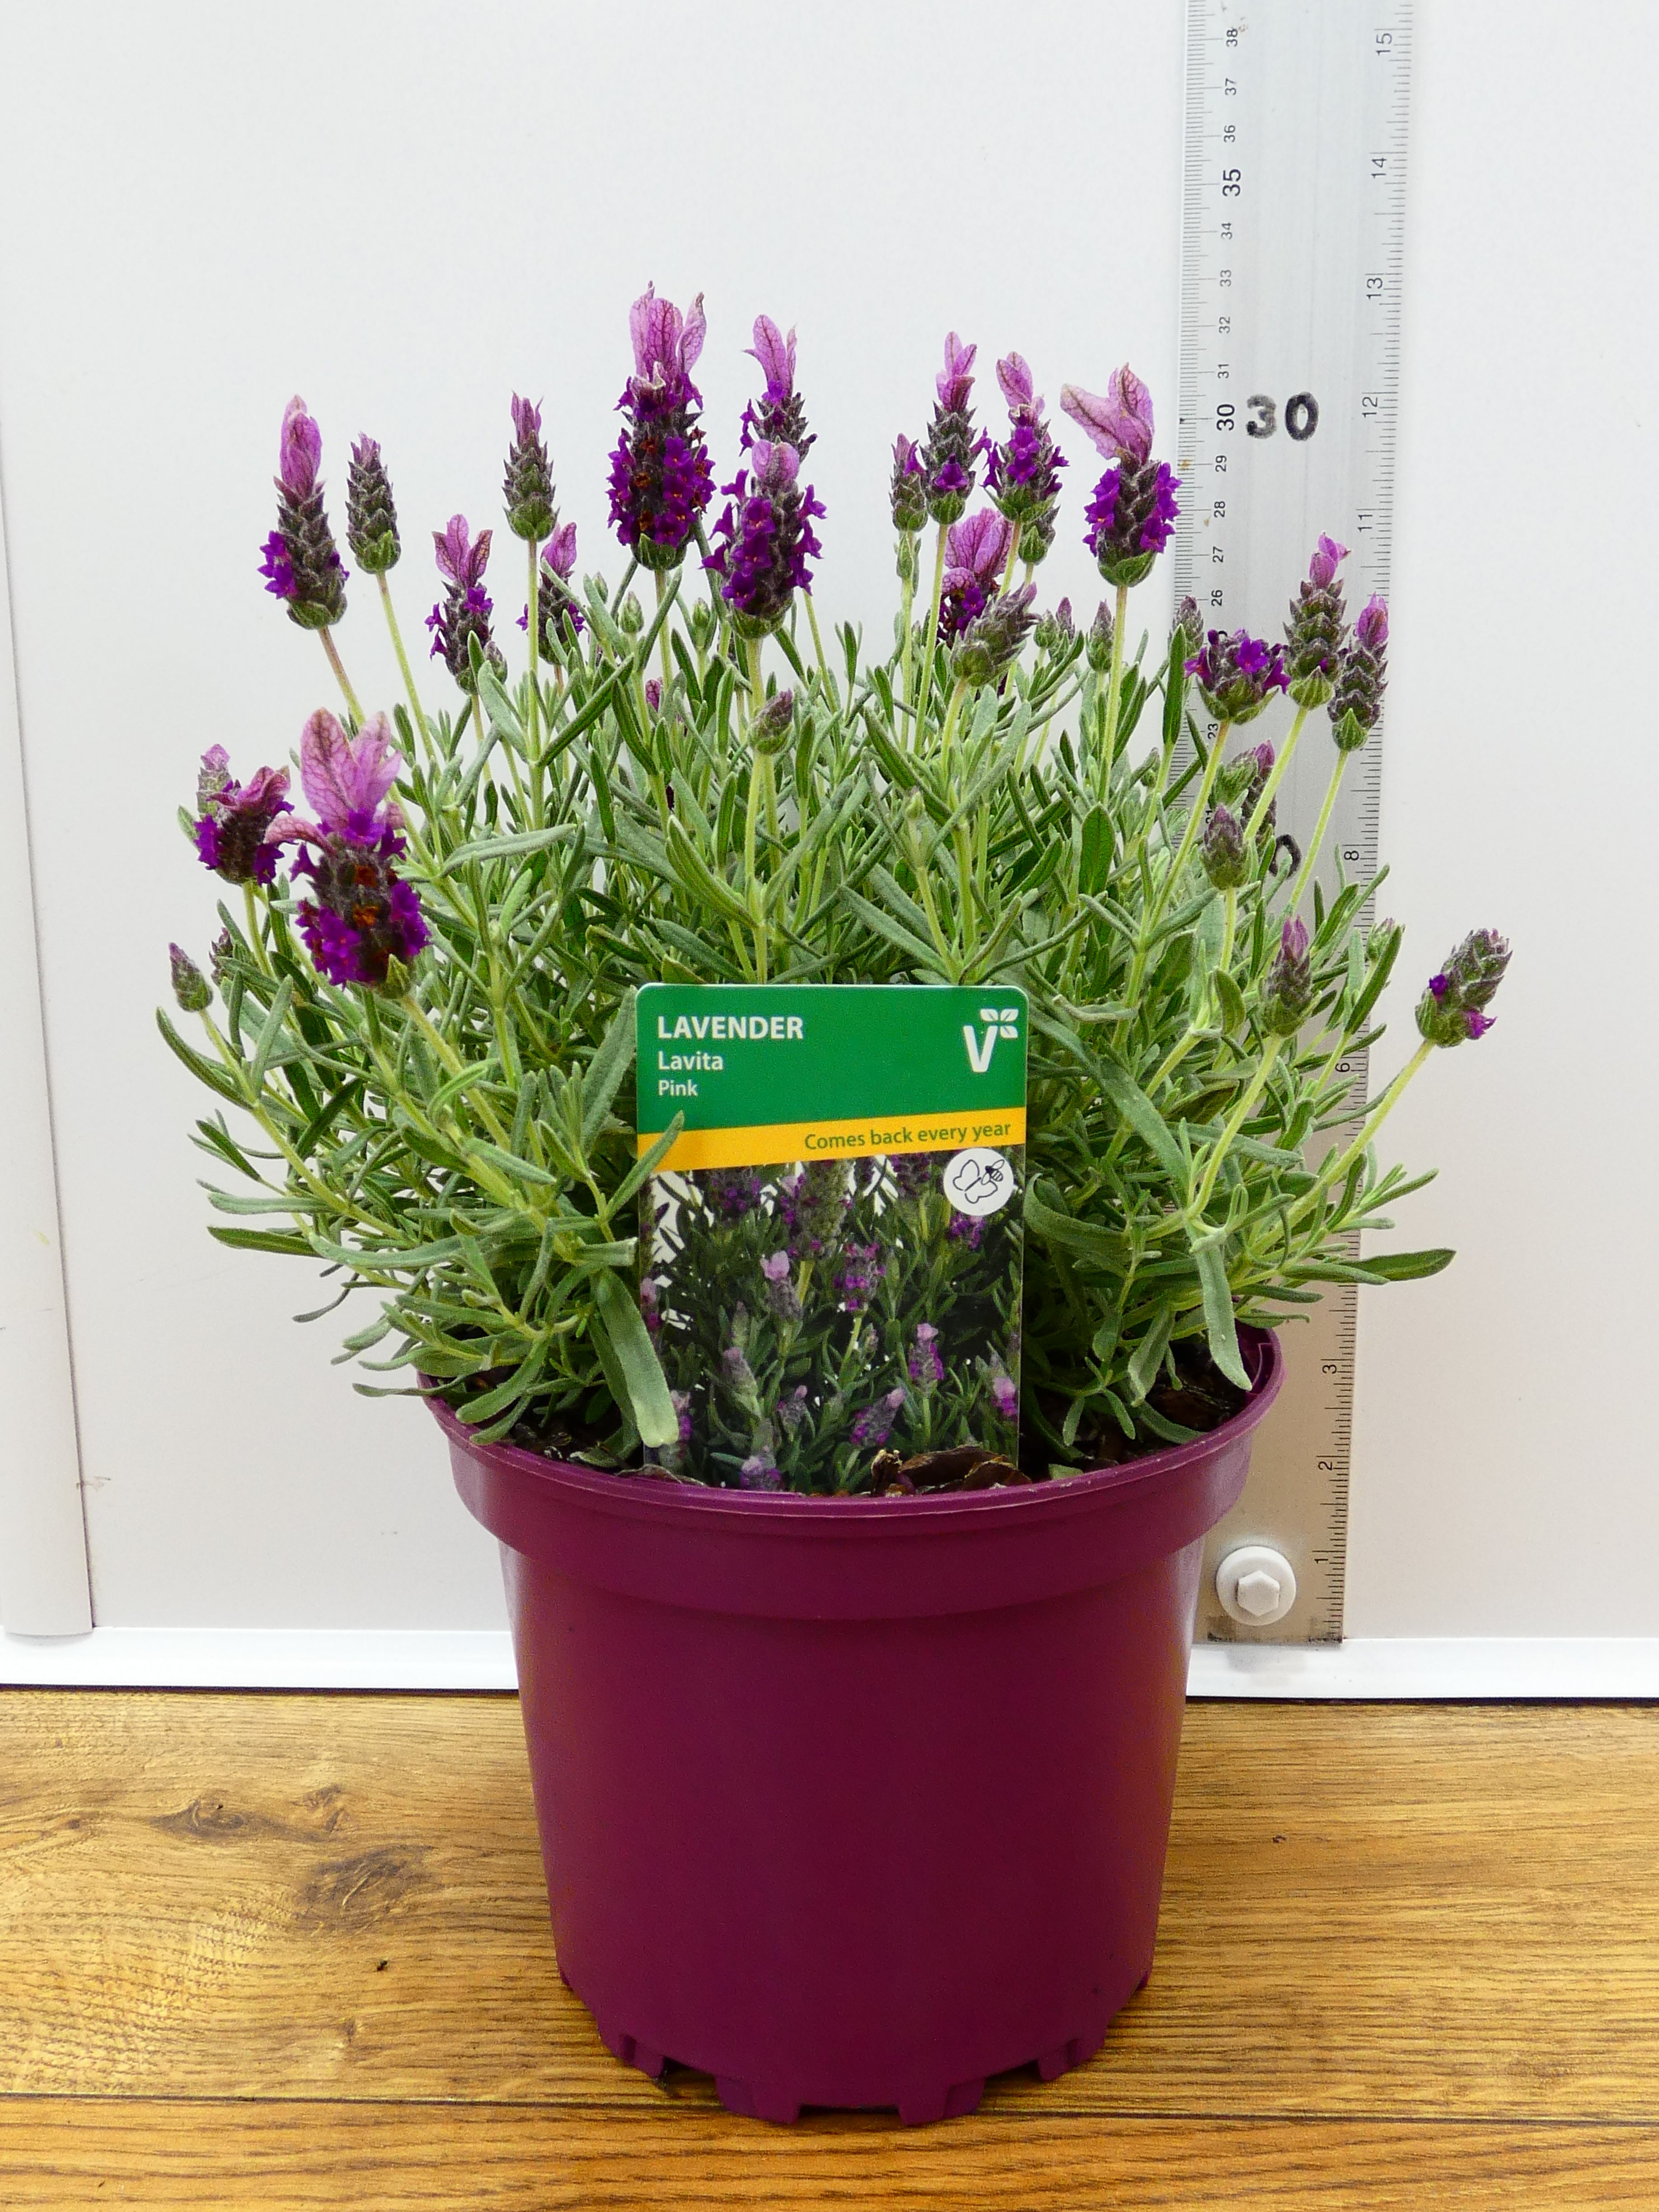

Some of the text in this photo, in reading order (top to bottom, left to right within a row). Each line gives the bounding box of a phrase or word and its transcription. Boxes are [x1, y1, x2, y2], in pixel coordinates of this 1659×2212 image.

[1226, 27, 1238, 47] 38
[1376, 33, 1392, 56] 15
[1224, 78, 1237, 96] 37
[1223, 125, 1236, 143] 36
[1371, 157, 1387, 178] 14
[1222, 169, 1241, 197] 35
[1220, 222, 1233, 240] 34
[1219, 269, 1232, 287] 33
[1366, 277, 1383, 300] 13
[1218, 316, 1231, 334] 32
[1217, 364, 1229, 379] 31
[1361, 396, 1378, 417] 12
[1216, 403, 1235, 431] 30
[1245, 391, 1319, 442] 30
[1214, 455, 1227, 473] 29
[1214, 501, 1226, 518] 28
[1357, 513, 1373, 533] 11
[1212, 546, 1224, 563] 27
[1210, 590, 1223, 607] 26
[1207, 723, 1218, 740] 23
[1343, 850, 1359, 861] 8
[658, 1016, 803, 1040] LAVENDER
[658, 1051, 723, 1070] Lavita
[1335, 1062, 1350, 1073] 6
[658, 1080, 698, 1097] Pink
[804, 1122, 1011, 1150] Comes back every year
[1322, 1364, 1337, 1374] 3
[1317, 1460, 1333, 1471] 2
[1313, 1556, 1329, 1564] 1
